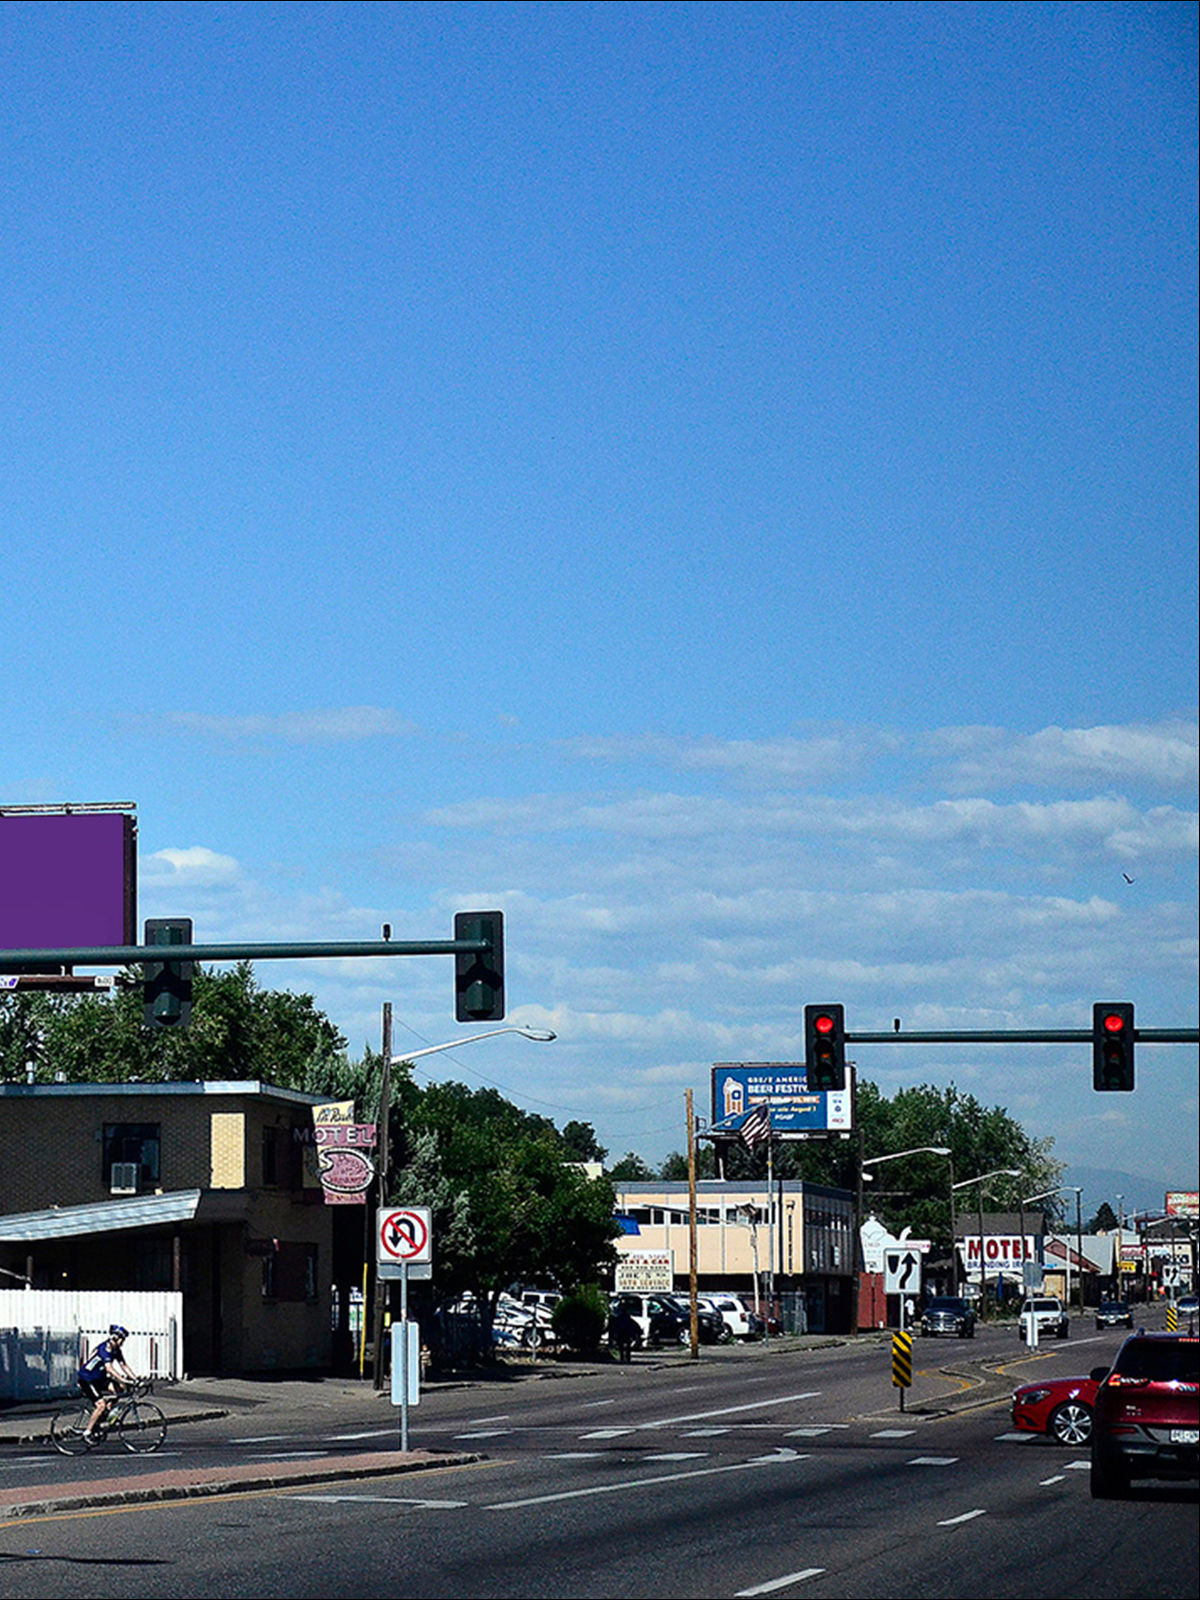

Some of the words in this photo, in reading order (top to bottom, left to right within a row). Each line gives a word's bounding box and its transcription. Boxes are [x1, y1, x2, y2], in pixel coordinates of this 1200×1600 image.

[747, 1085, 774, 1094] BEER
[775, 1085, 810, 1094] FESTIV
[294, 1127, 374, 1143] MOTEL
[968, 1239, 1032, 1260] MOTEL
